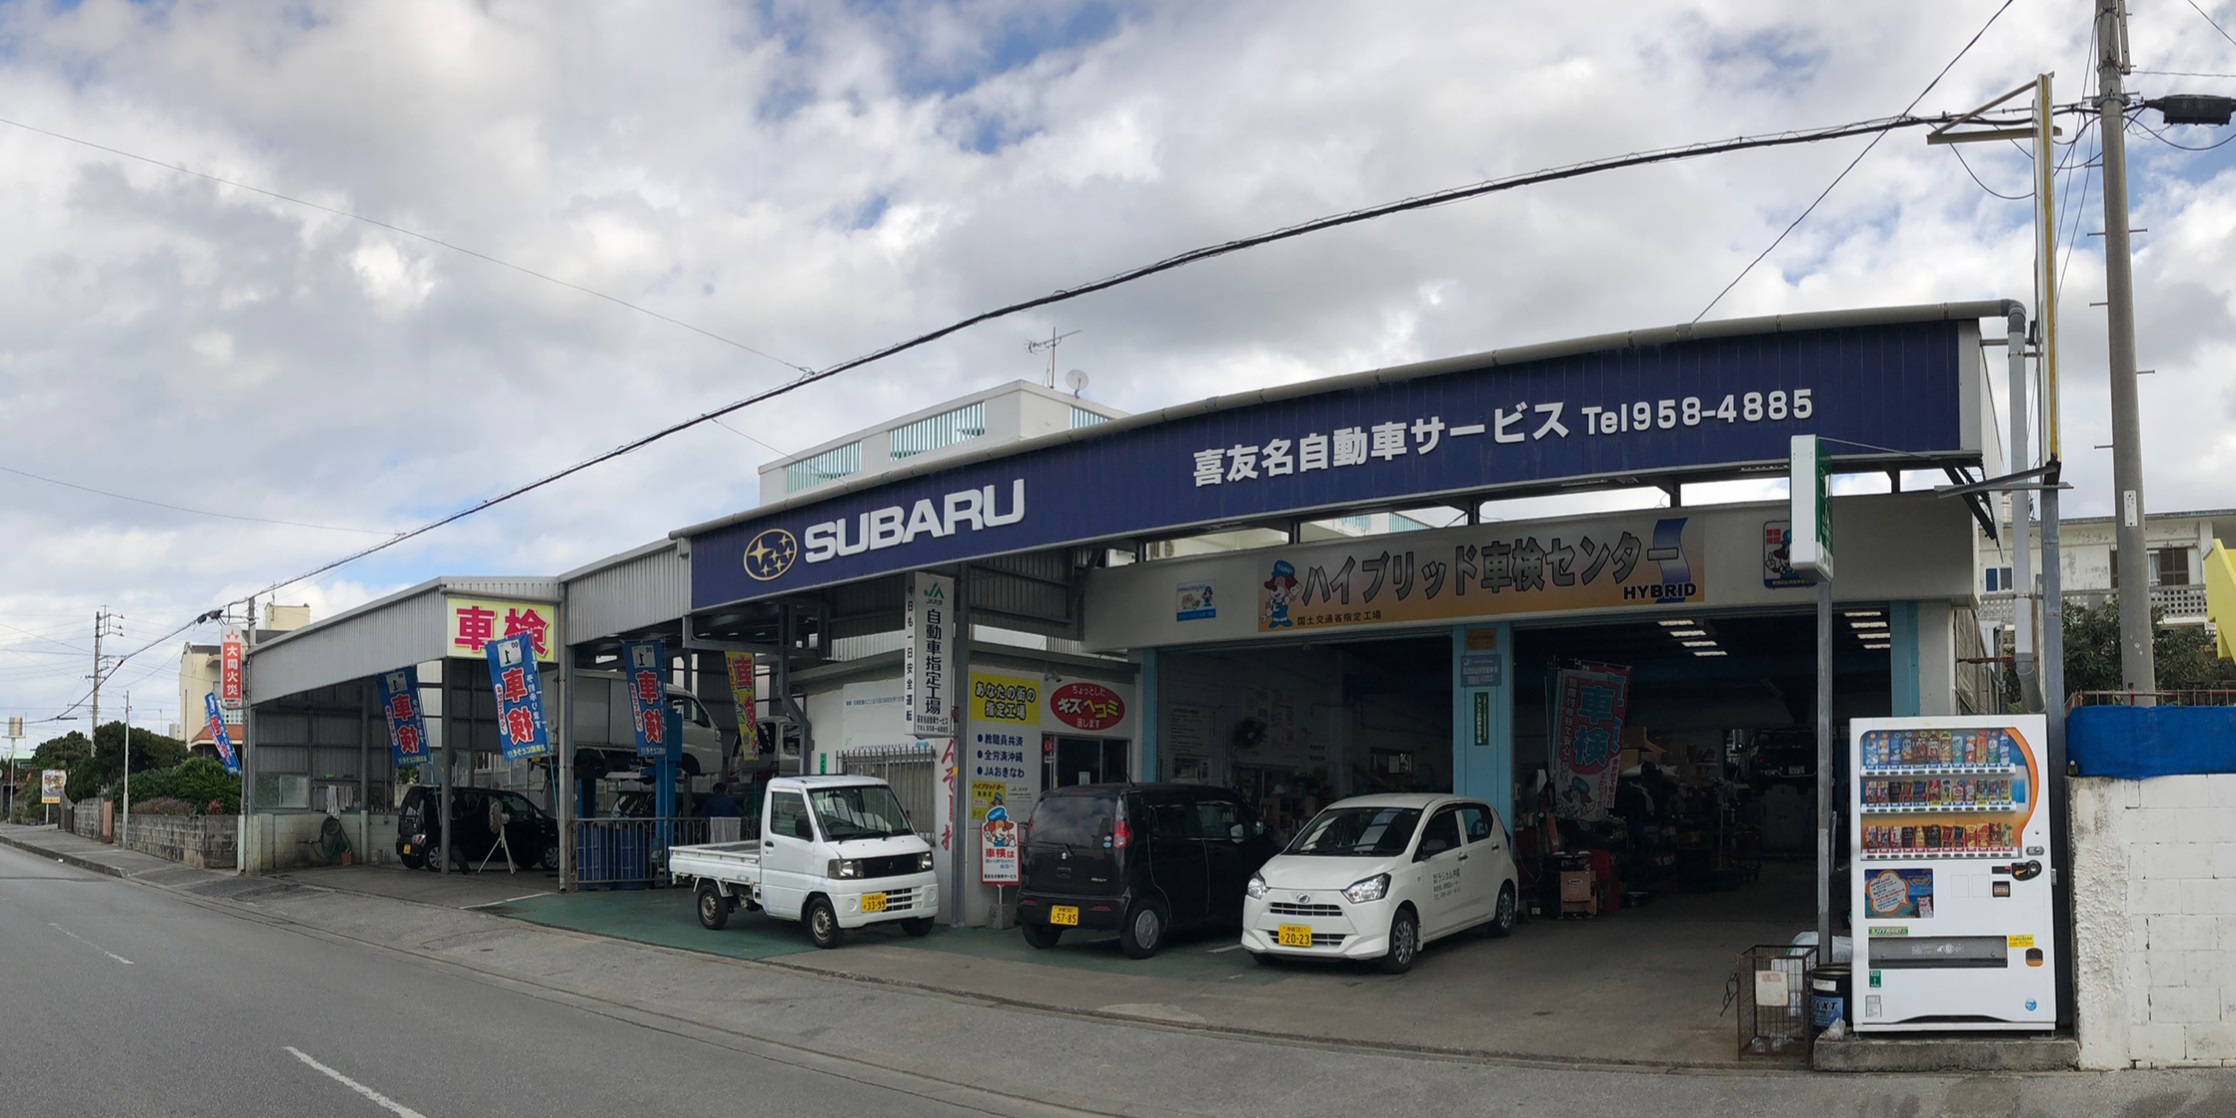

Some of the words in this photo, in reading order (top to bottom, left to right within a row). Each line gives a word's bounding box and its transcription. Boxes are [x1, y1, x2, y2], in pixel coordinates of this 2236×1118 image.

[1193, 402, 1570, 487] 喜友名自動車サービス
[804, 478, 1025, 564] SUBARU
[1301, 531, 1679, 607] ハイブリッド車検センター
[1622, 582, 1697, 601] HYBRID
[1297, 610, 1382, 627] 国土交通省指定工場
[454, 605, 549, 657] 車検
[906, 585, 914, 723] 今日も一日安全運転
[925, 608, 942, 715] 自動車指定工場
[226, 645, 239, 697] 大同火災
[975, 681, 1036, 703] あなたの街の
[1071, 684, 1106, 697] ちょっとした
[985, 700, 1027, 721] 指定工場
[1573, 684, 1617, 767] 車検
[984, 733, 1023, 747] 教職員共済
[984, 750, 1024, 763] 全労済沖縄
[984, 766, 1025, 779] JAおきなわ
[984, 848, 1015, 859] 車検は
[1286, 932, 1309, 945] 20-23
